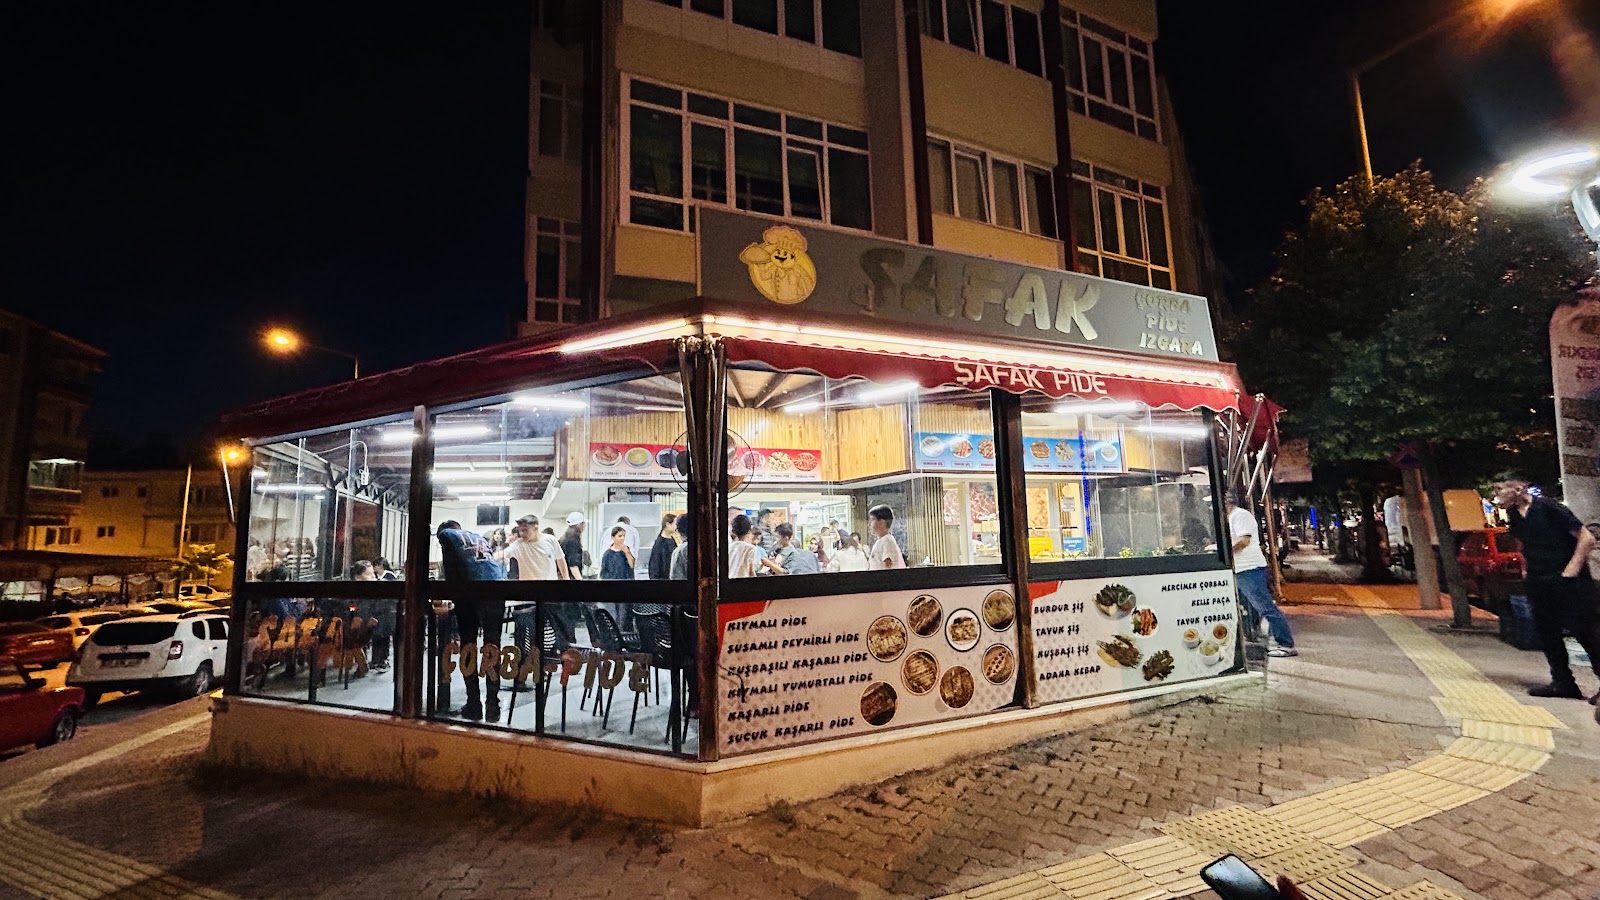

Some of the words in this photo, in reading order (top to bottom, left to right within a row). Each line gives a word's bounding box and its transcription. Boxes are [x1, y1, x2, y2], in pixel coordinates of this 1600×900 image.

[1134, 287, 1192, 314] ÇORBA
[1146, 311, 1188, 334] PİDE
[1140, 332, 1203, 356] IZGARA
[953, 360, 1044, 389] ŞAFAK
[1161, 582, 1197, 592] MERCİMEK
[1200, 580, 1229, 590] ÇORBASI
[1034, 603, 1069, 614] BURDUR
[1072, 600, 1084, 613] ŞİŞ
[1191, 598, 1210, 607] KELLE
[1212, 597, 1231, 606] PAÇA
[727, 618, 777, 631] KIYMALI
[781, 615, 807, 627] PİDE
[1036, 625, 1064, 637] TAVUK
[1067, 622, 1080, 635] ŞİŞ
[1177, 617, 1200, 626] TAVUK
[1203, 613, 1233, 625] ÇORBASI
[727, 640, 778, 654] SUSAMLI
[782, 632, 831, 650] PEYNİRLİ
[835, 629, 860, 643] PİDE
[1037, 646, 1074, 660] KUŞBAŞI
[1077, 643, 1089, 656] ŞİŞ
[792, 655, 840, 671] KAŞARLI
[844, 651, 868, 664] PİDE
[783, 678, 845, 692] YUMURTALI
[849, 671, 873, 684] PİDE
[1039, 669, 1071, 681] ADANA
[1073, 665, 1101, 676] KEBAP
[727, 705, 779, 722] KAŞARLI
[783, 701, 810, 715] PİDE
[727, 730, 768, 745] SUCUK
[774, 721, 824, 737] KAŞARLI
[829, 716, 855, 729] PİDE
